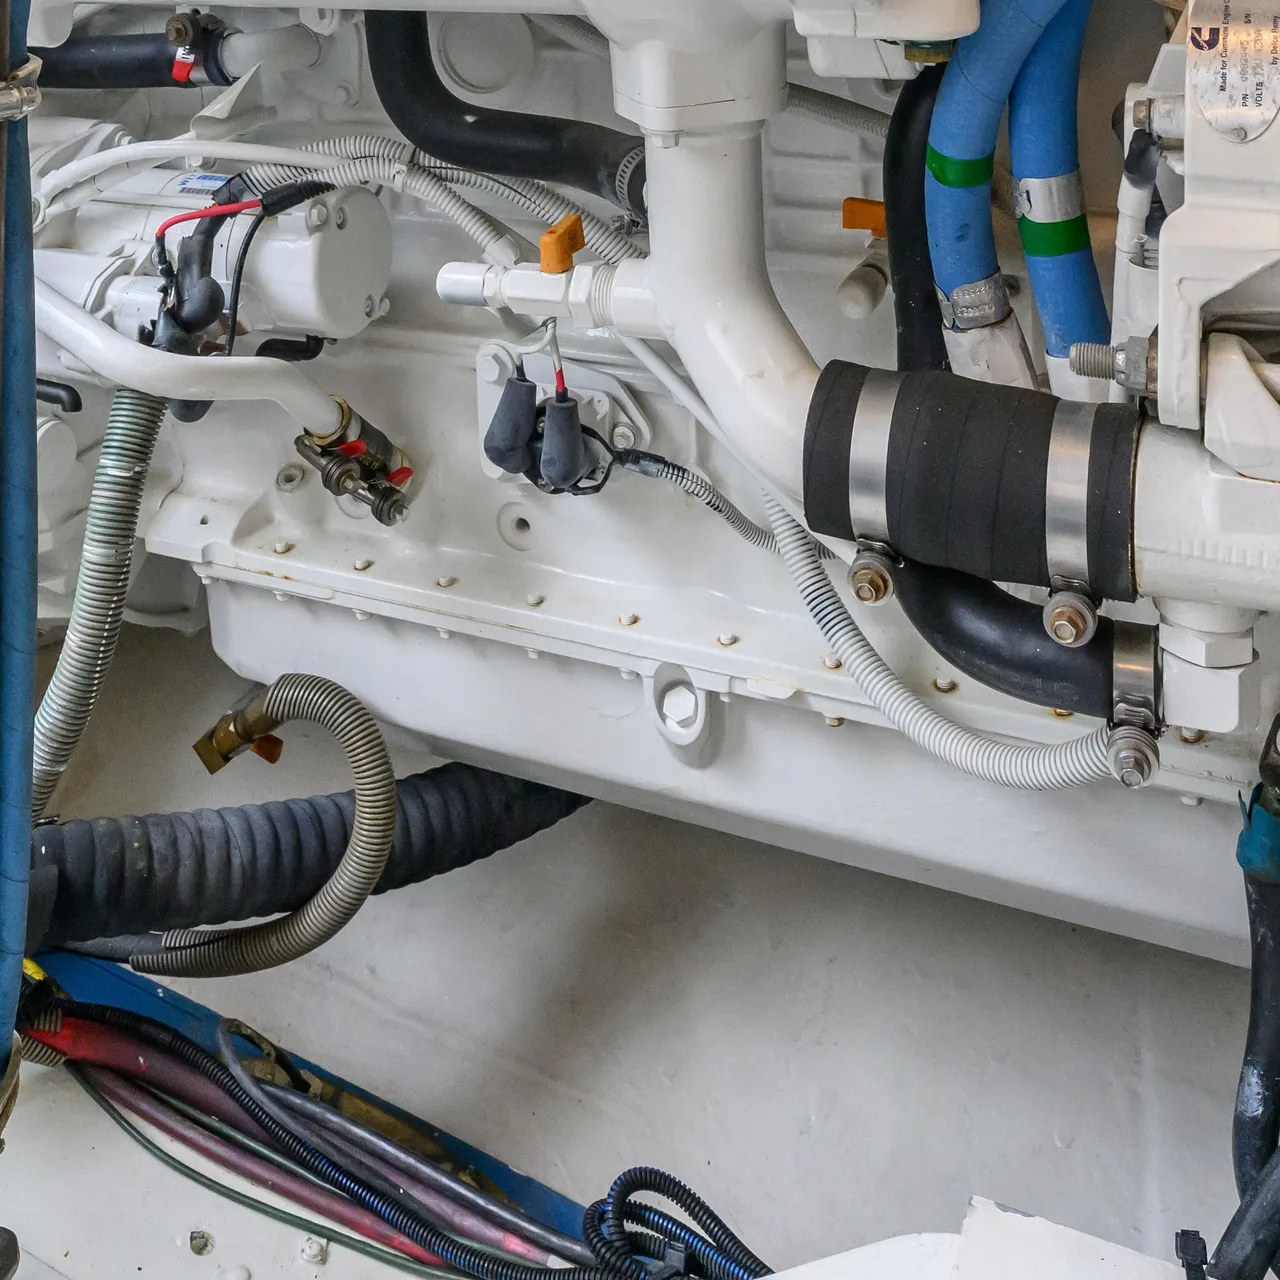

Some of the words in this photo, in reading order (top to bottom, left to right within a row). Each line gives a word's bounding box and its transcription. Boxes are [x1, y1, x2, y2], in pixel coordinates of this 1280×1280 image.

[1222, 4, 1231, 24] Engine
[1244, 13, 1252, 25] S/N
[1271, 15, 1280, 34] Remy
[1221, 26, 1230, 58] Cummins
[1270, 35, 1279, 54] Delco
[1220, 60, 1228, 70] for
[1270, 56, 1279, 66] by
[1219, 72, 1228, 92] Made
[1241, 93, 1250, 107] P/N
[1254, 81, 1264, 108] VOLTS
